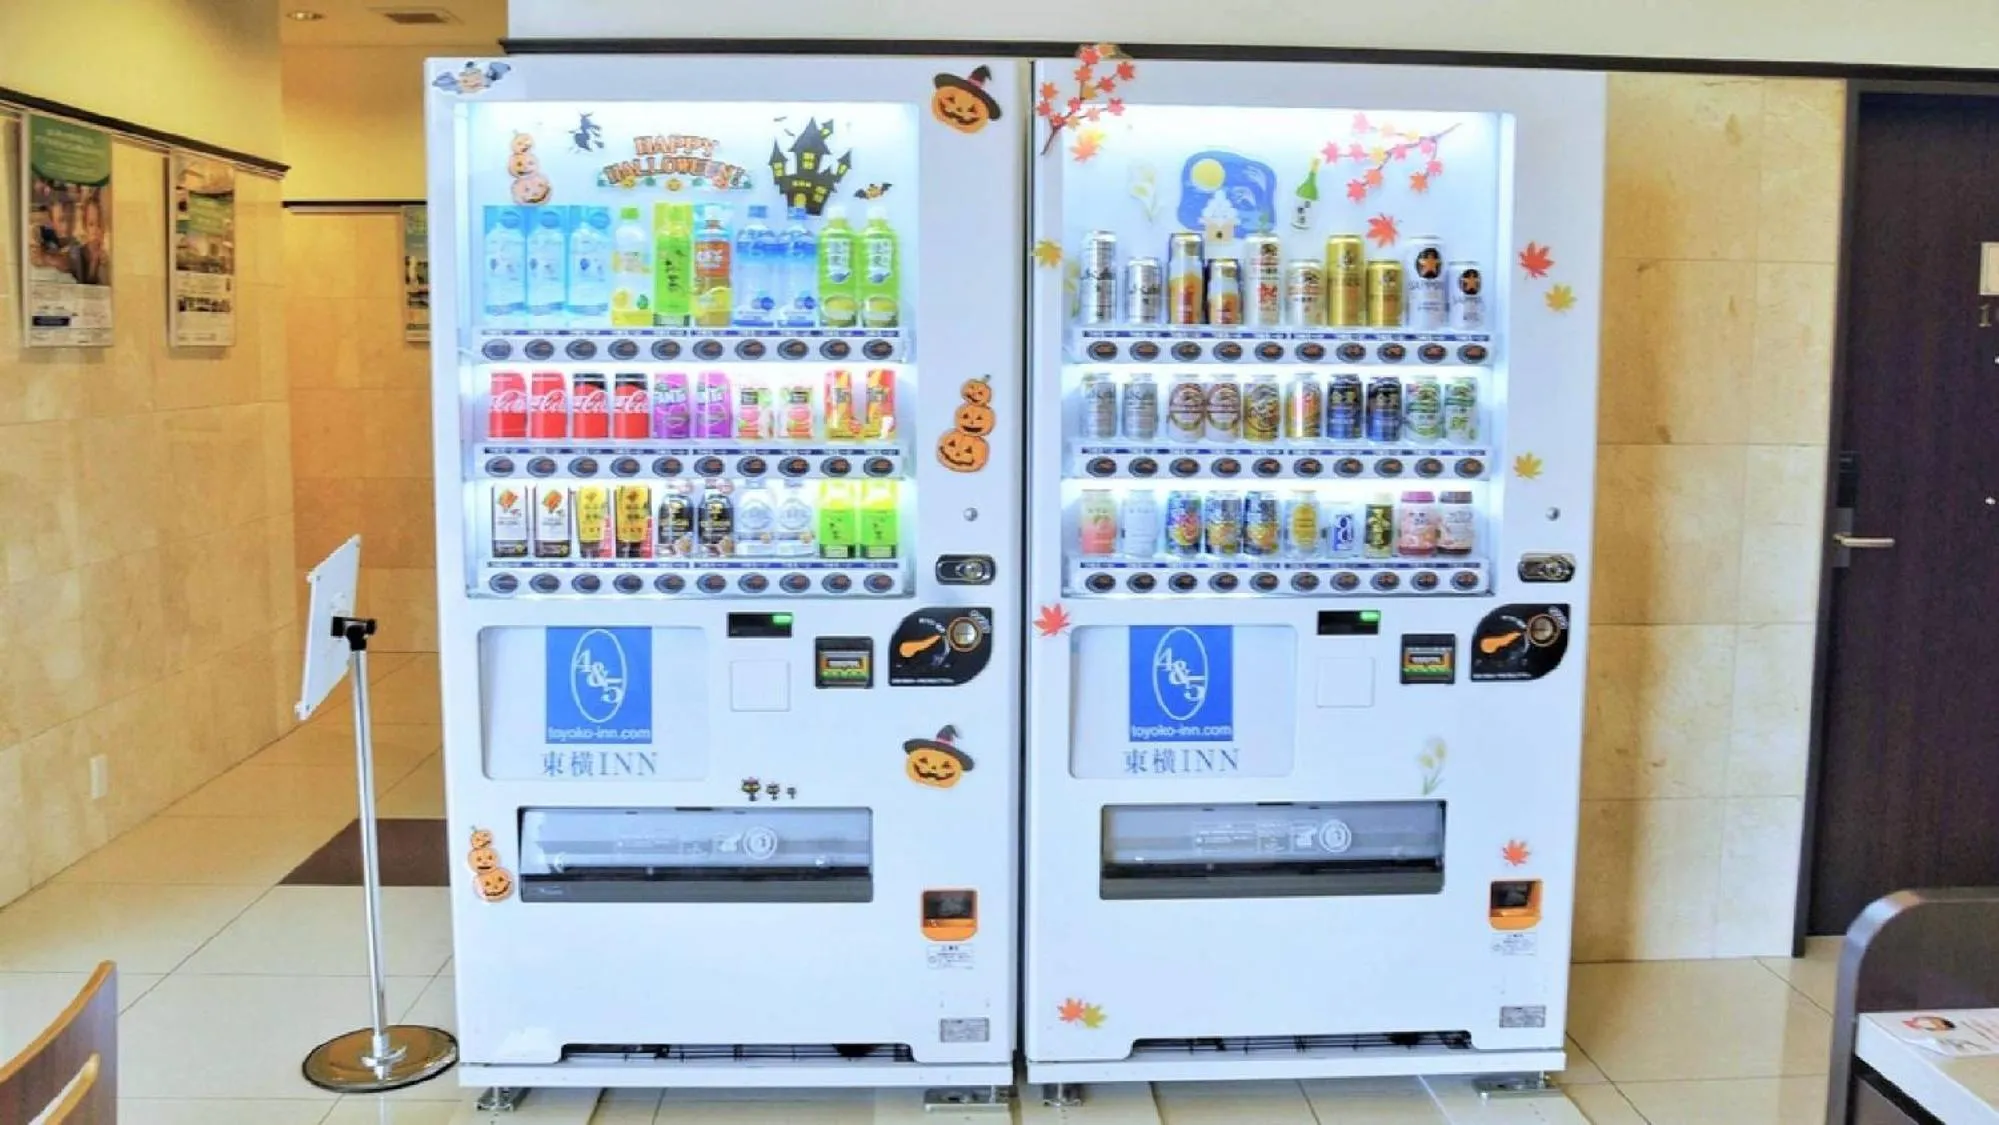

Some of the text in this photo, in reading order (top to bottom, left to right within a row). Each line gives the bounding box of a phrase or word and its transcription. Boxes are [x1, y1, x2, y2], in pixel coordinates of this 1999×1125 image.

[633, 134, 720, 158] HAPPY
[548, 725, 651, 742] toyoko-inn.com
[1131, 723, 1232, 740] toyoko-inn.com
